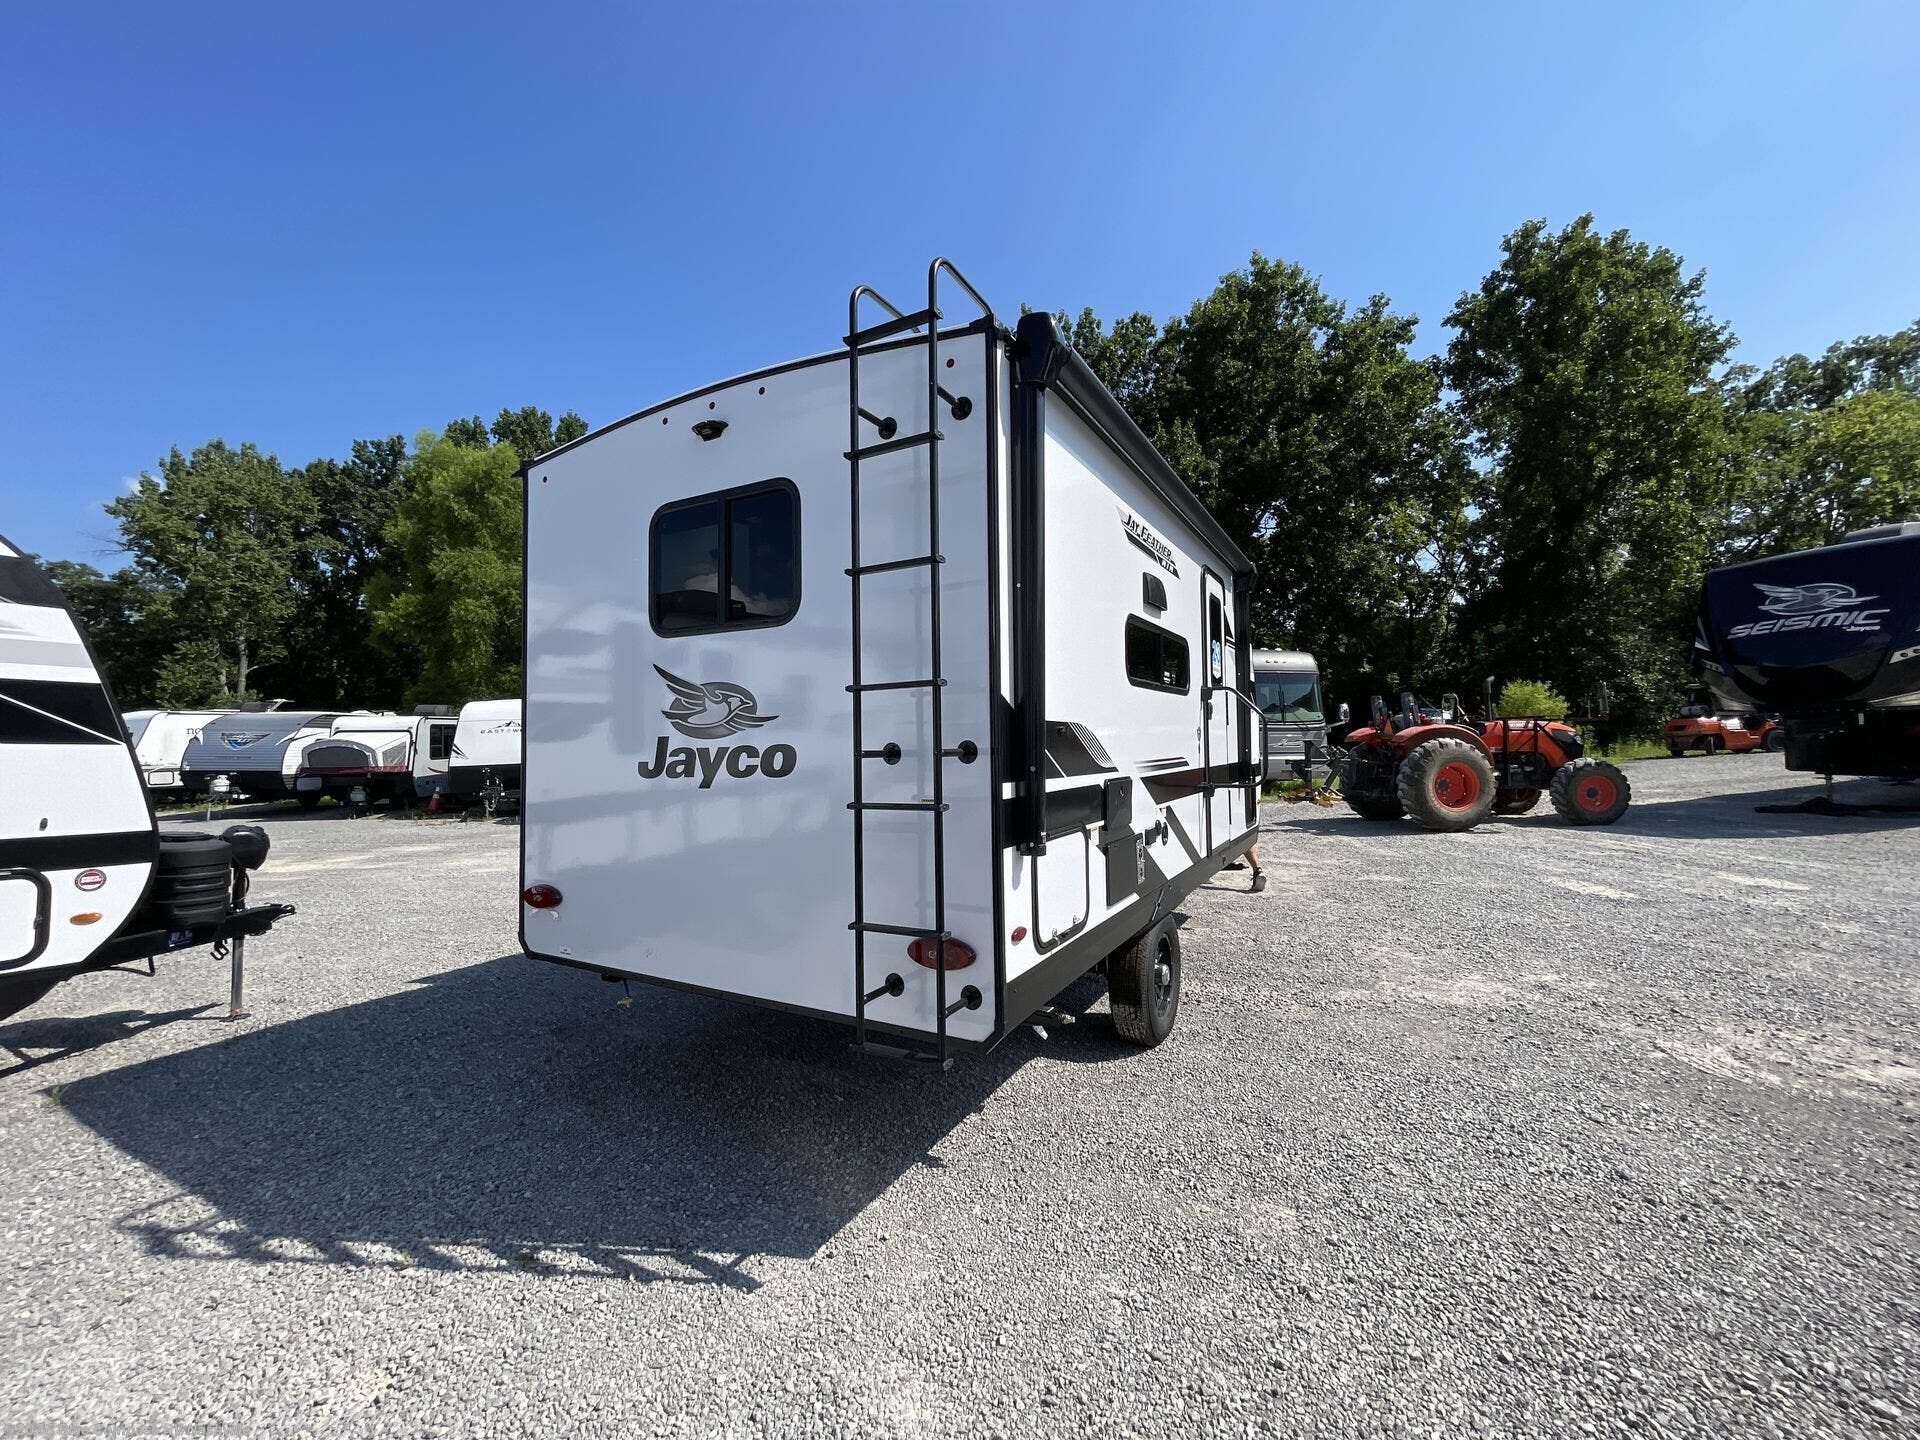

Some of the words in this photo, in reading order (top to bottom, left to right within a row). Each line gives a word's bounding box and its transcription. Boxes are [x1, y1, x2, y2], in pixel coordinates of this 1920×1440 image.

[1123, 513, 1140, 534] JAY
[1140, 525, 1172, 558] FEATHER
[1727, 608, 1891, 640] SEISMIC
[637, 736, 797, 789] Jayco
